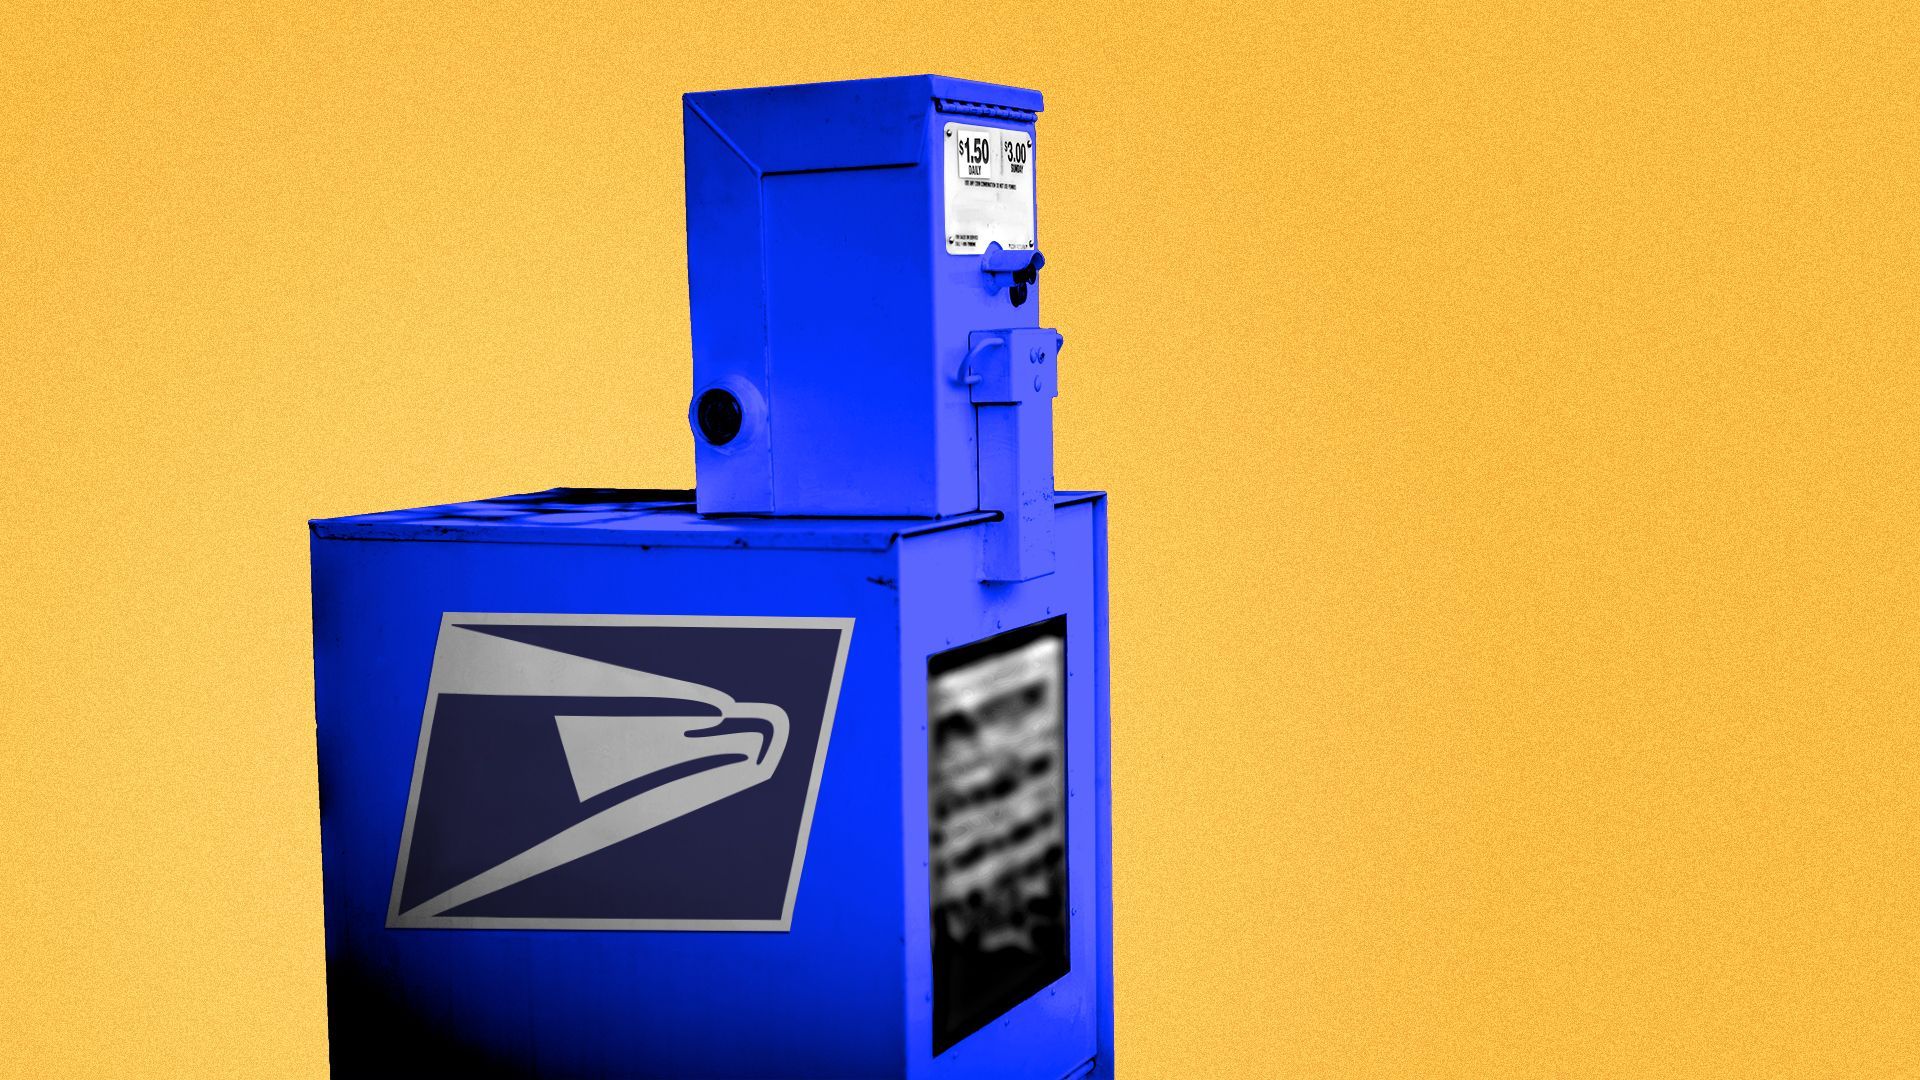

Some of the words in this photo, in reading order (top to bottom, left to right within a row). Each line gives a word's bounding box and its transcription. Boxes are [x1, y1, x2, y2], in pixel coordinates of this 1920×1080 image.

[959, 137, 989, 164] $1.50
[1004, 141, 1027, 163] $3.00
[968, 165, 981, 175] DAILY
